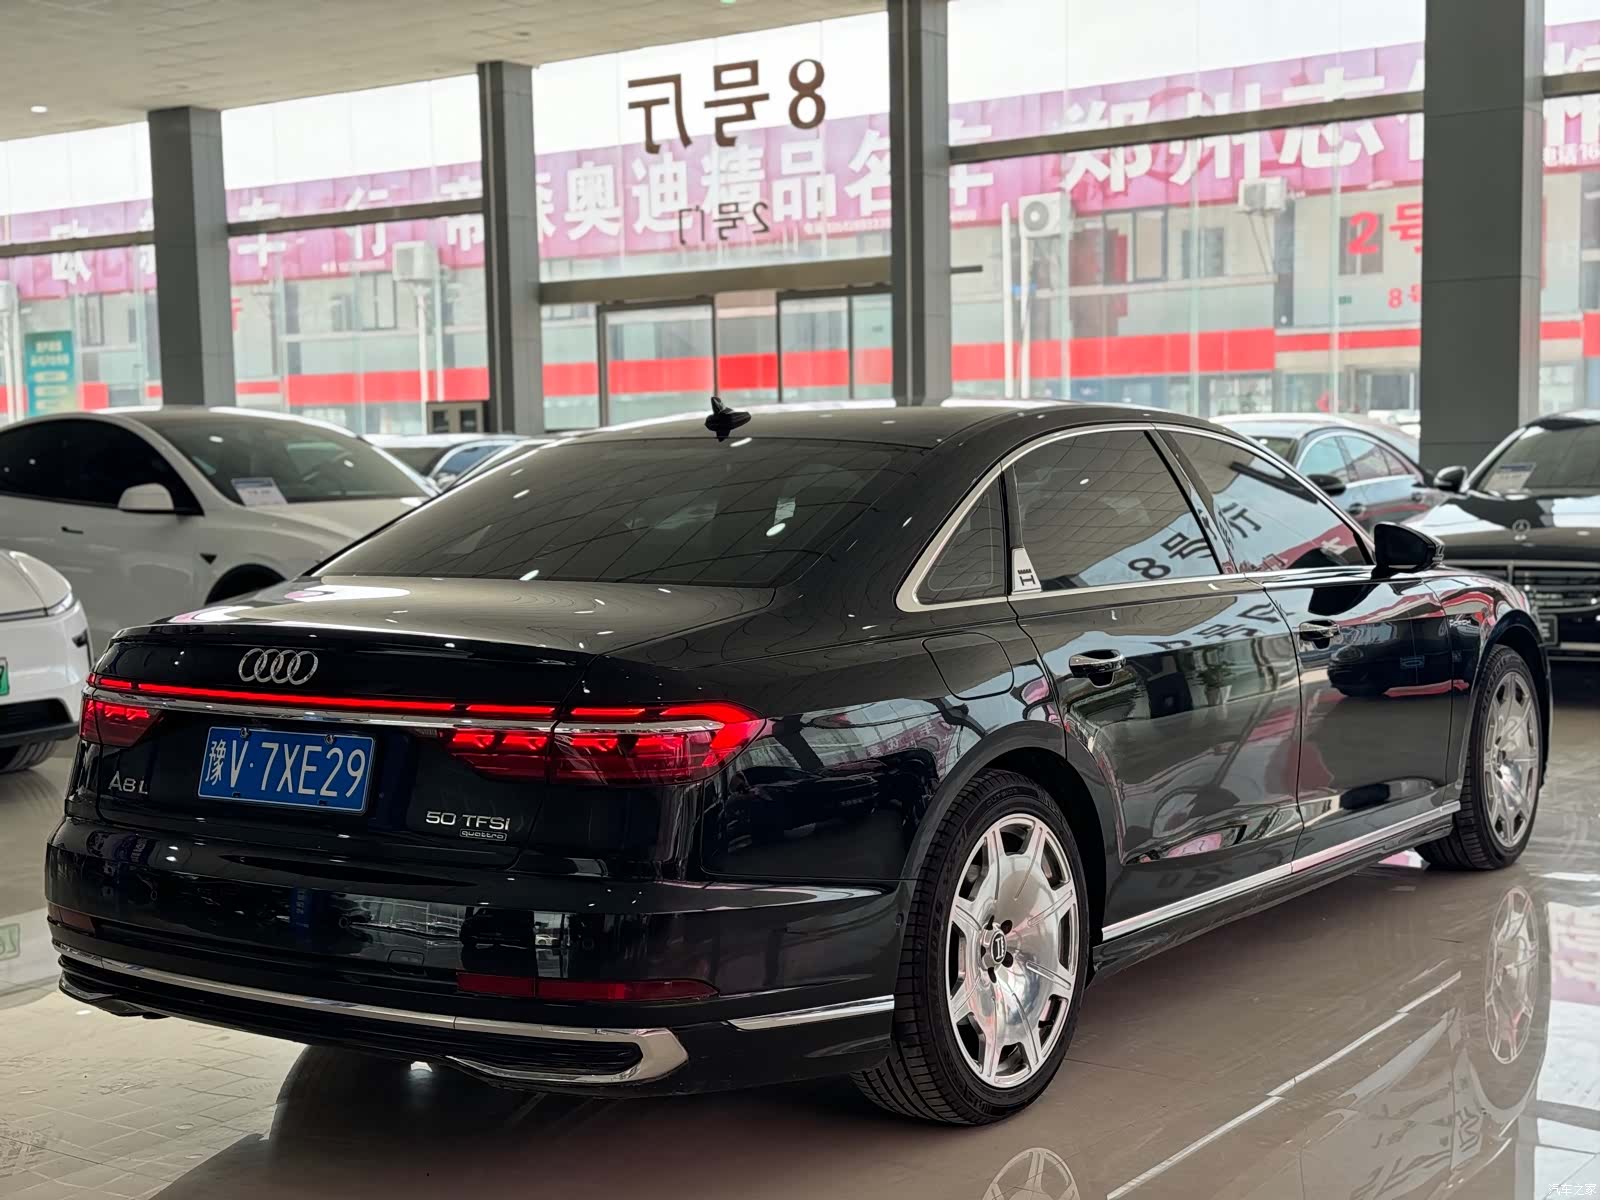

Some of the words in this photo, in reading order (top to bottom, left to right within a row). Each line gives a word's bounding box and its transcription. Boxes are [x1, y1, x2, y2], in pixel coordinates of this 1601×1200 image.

[205, 738, 367, 798] 豫V·7XE29
[425, 811, 456, 826] 50
[460, 829, 505, 840] quattro
